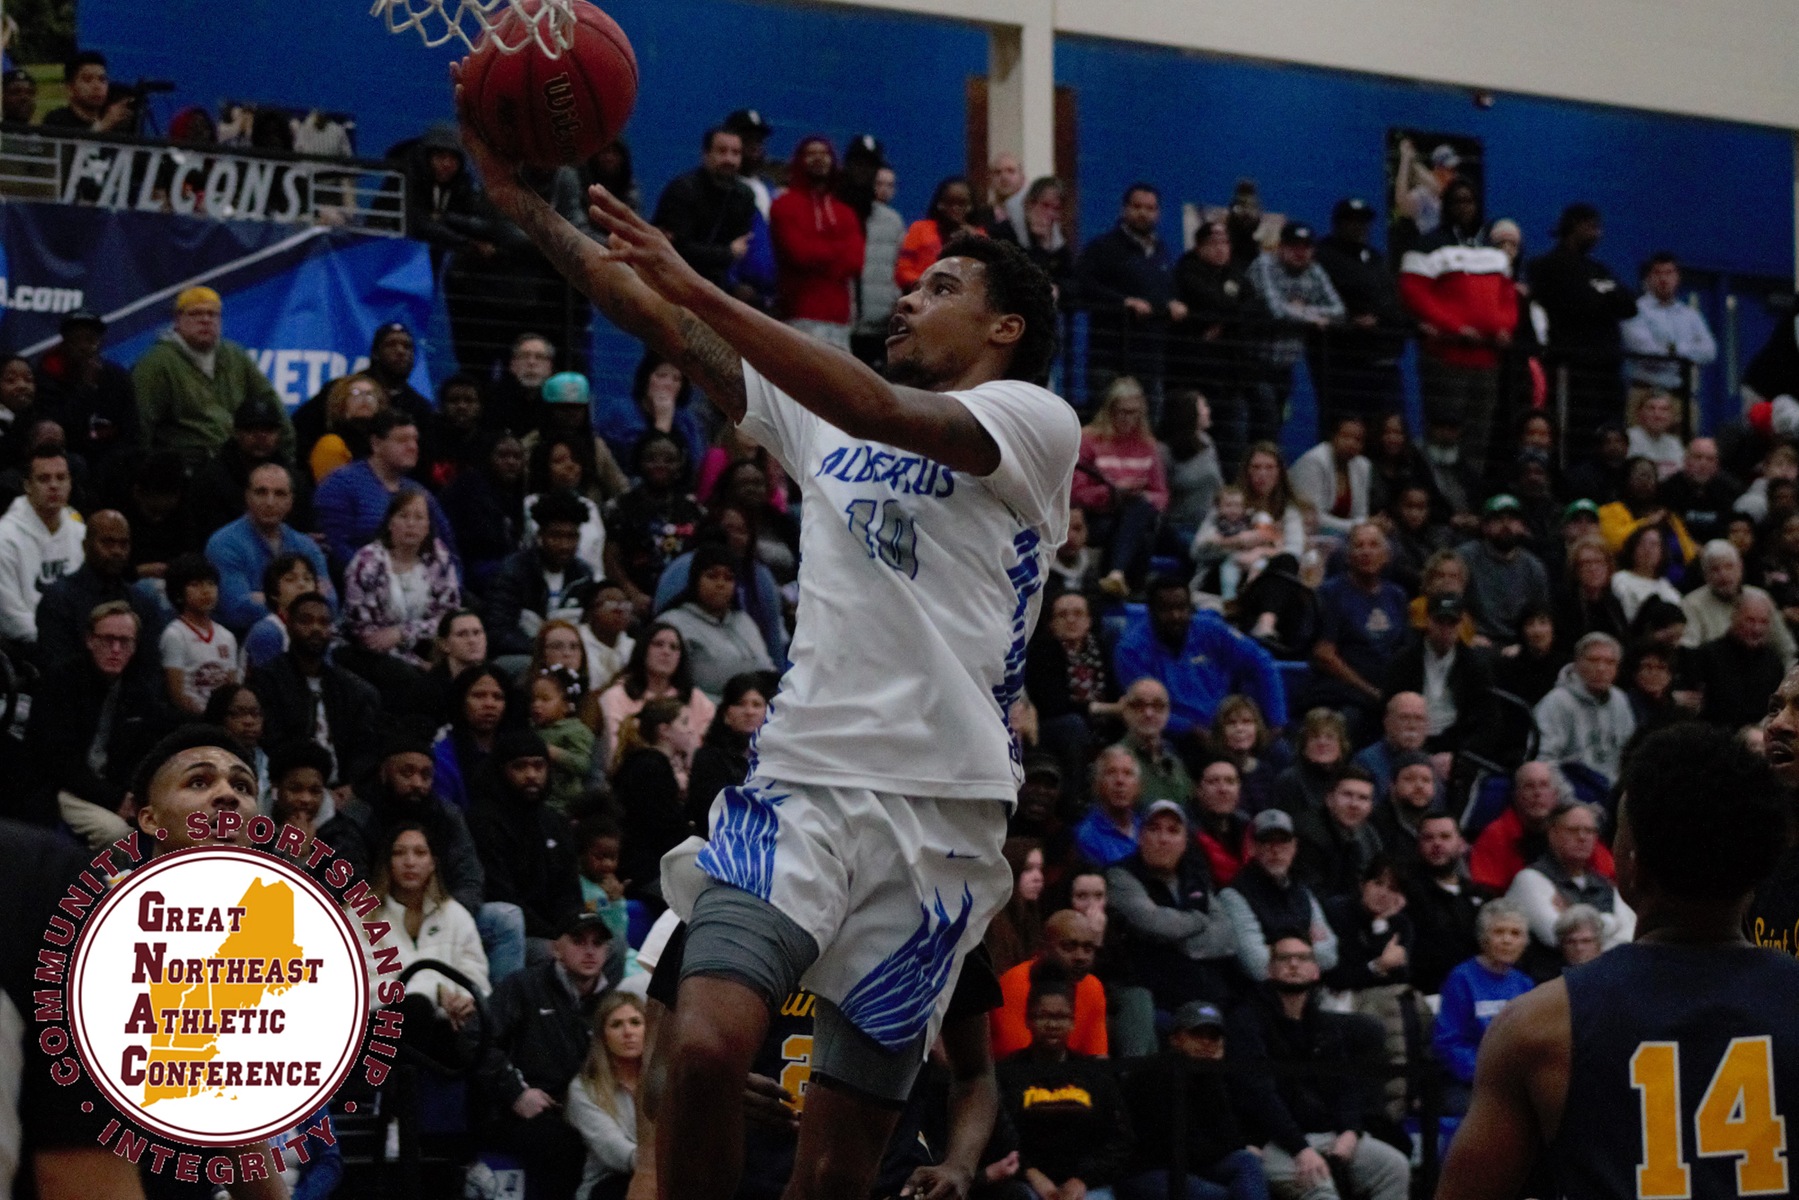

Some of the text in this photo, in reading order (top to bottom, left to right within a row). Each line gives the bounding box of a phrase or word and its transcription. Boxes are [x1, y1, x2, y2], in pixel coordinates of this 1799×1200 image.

[62, 143, 309, 222] FALCONS
[815, 445, 955, 498] ALBERTUS
[845, 499, 919, 581] 10
[1629, 1034, 1790, 1200] 14
